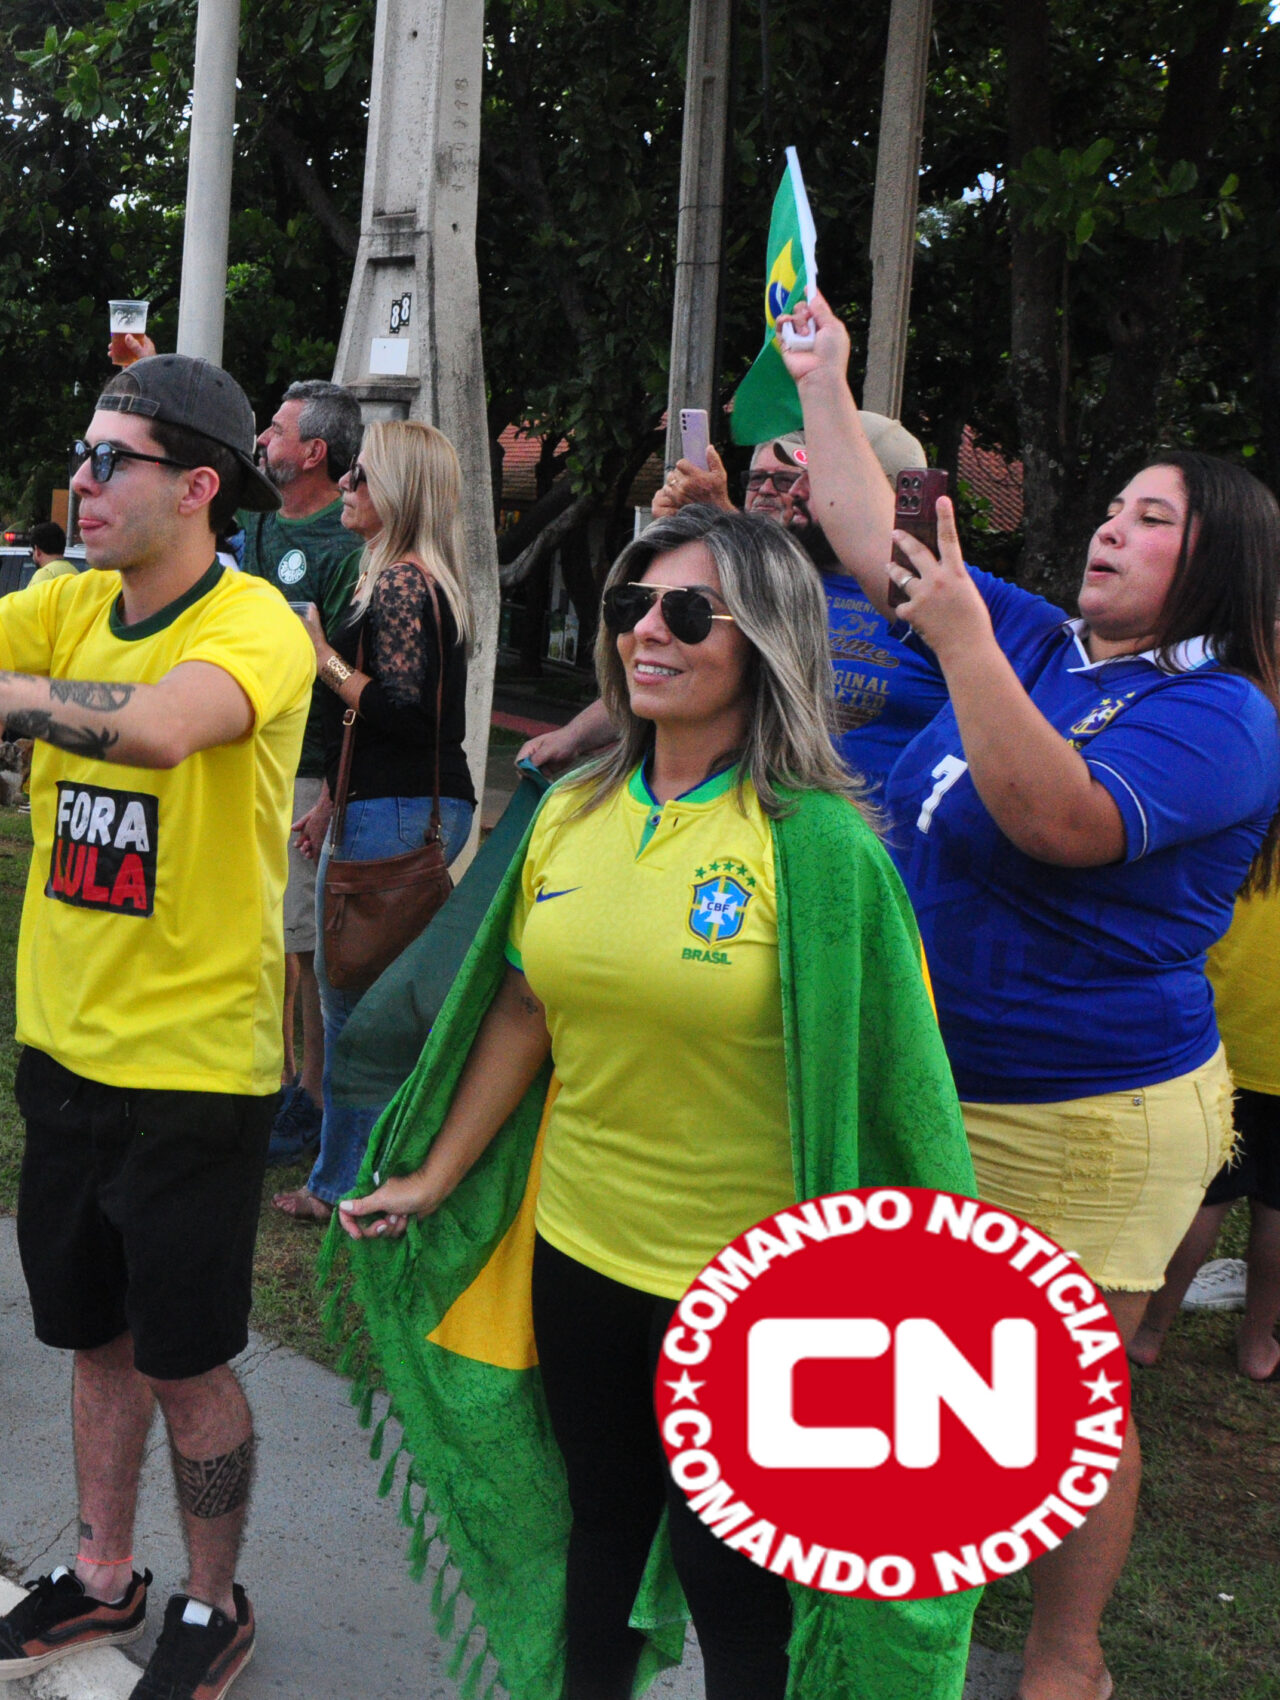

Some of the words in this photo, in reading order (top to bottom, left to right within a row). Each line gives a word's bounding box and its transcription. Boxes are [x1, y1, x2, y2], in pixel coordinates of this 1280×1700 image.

[391, 297, 410, 328] 88
[834, 670, 890, 695] GINAL
[916, 754, 968, 834] 7
[57, 789, 150, 852] FORA
[52, 837, 148, 910] LULA
[707, 902, 730, 913] CBF
[681, 947, 732, 965] BRASIL
